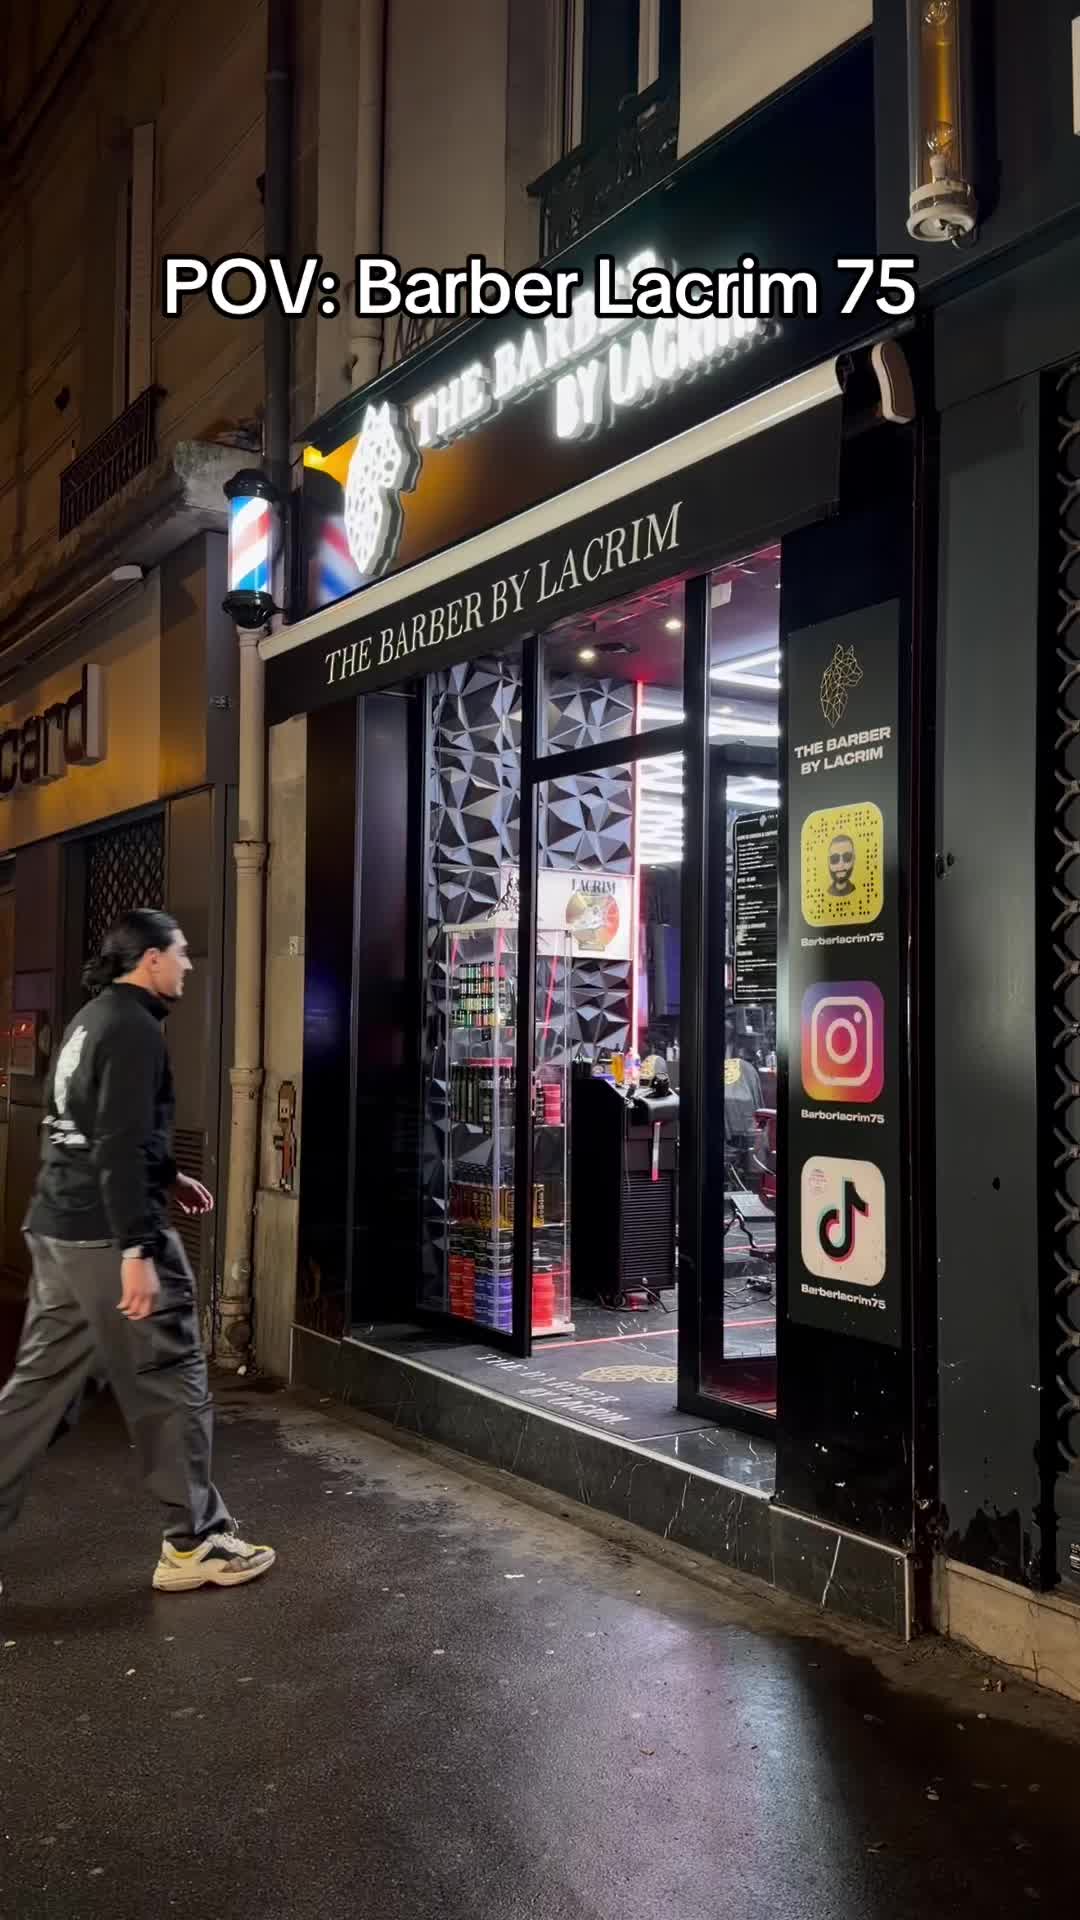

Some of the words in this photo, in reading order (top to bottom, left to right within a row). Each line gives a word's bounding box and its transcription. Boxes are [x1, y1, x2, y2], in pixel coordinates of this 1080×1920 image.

[412, 361, 486, 447] THE
[555, 357, 603, 440] BY
[324, 636, 373, 685] THE
[377, 591, 485, 666] BARBER
[490, 568, 531, 623] BY
[536, 500, 684, 604] LACRIM
[794, 741, 824, 759] THE
[826, 726, 891, 752] BARBER
[801, 760, 821, 775] BY
[823, 745, 884, 770] LACRIM
[571, 877, 617, 896] LACRIM
[800, 1284, 887, 1310] Barberlacrim75
